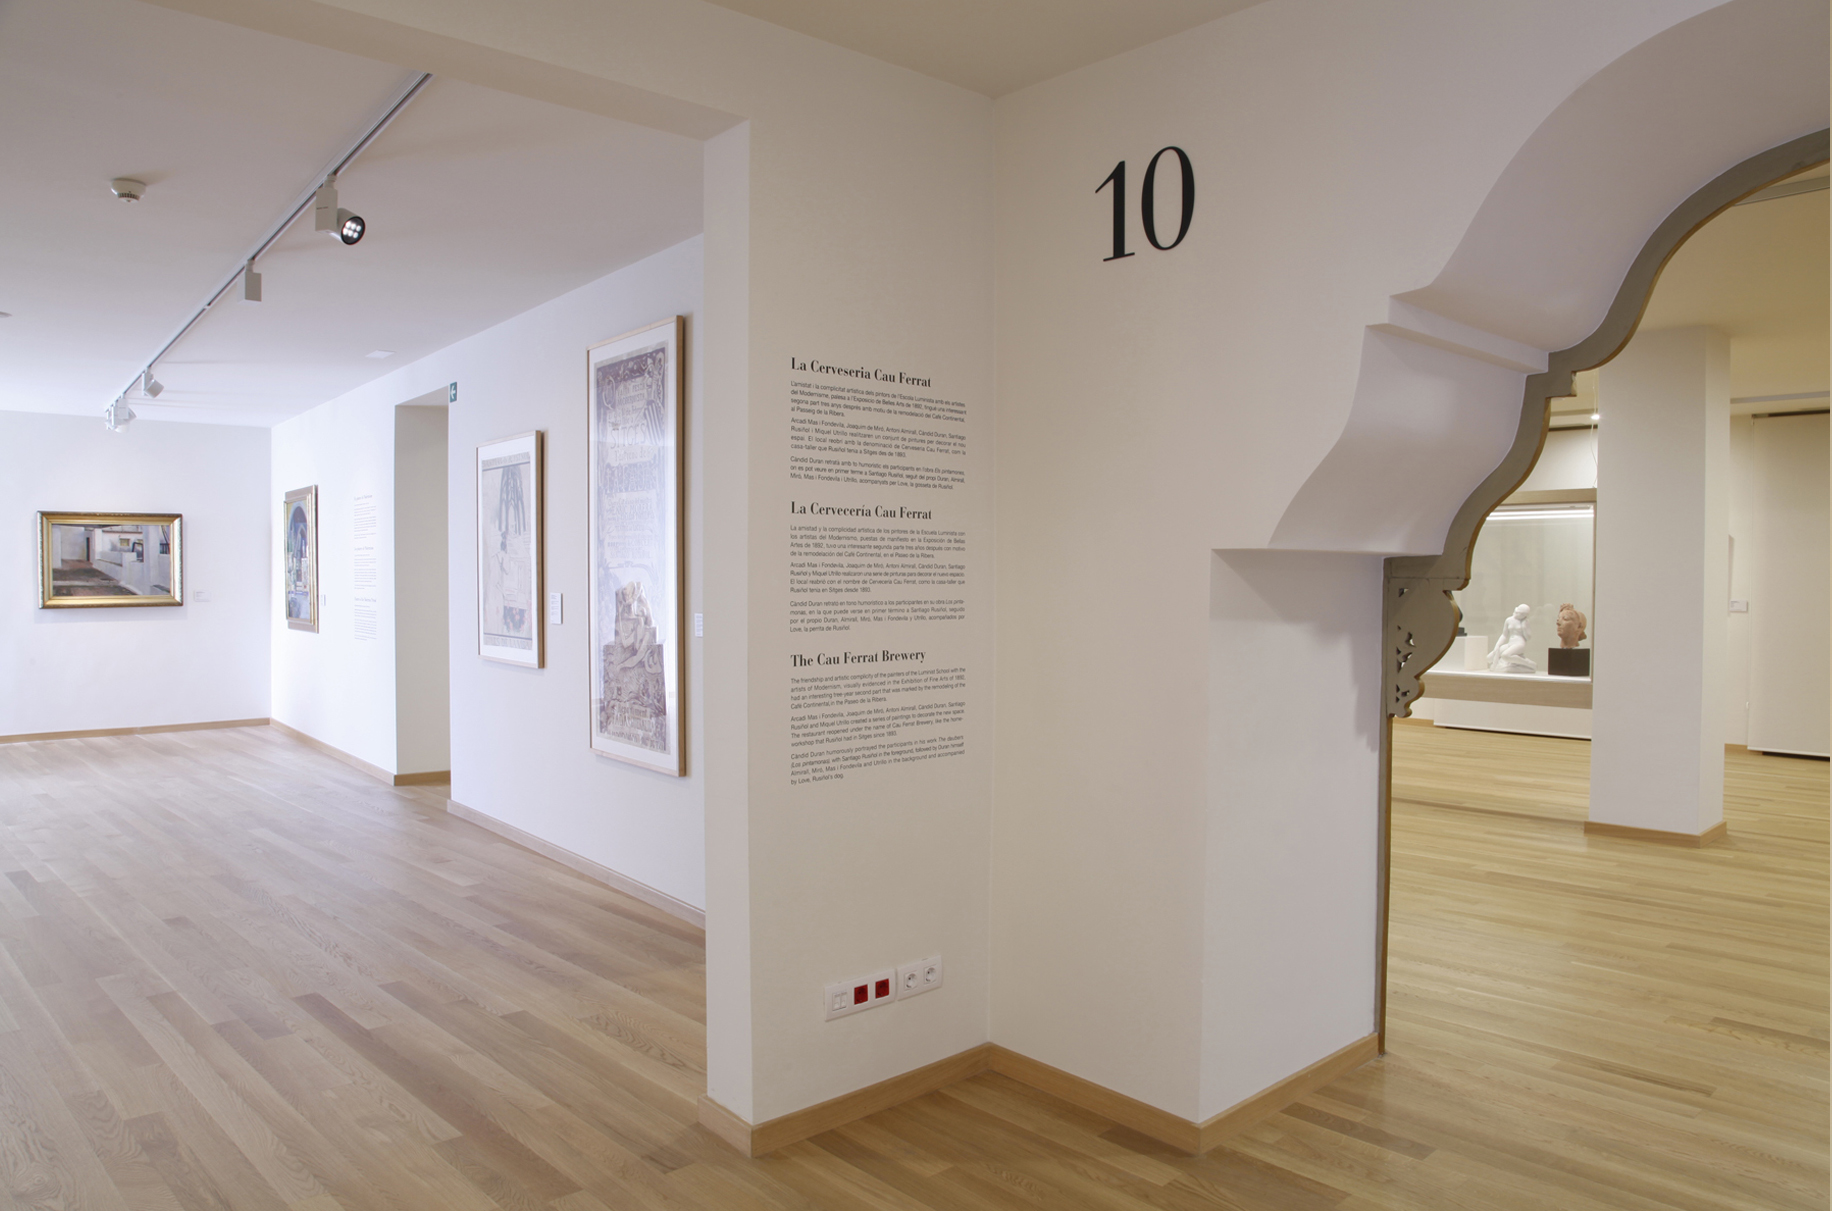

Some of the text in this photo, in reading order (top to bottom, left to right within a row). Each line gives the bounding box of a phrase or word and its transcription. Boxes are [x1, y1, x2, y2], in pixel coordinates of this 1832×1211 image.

[1095, 145, 1195, 262] 10
[791, 357, 931, 388] La Cerveseria Cau Ferrat
[796, 406, 815, 415] Passeig
[815, 427, 831, 435] Miquel
[846, 422, 866, 431] Joaquim
[863, 448, 878, 456] Sitges
[868, 469, 887, 478] Santiago
[791, 501, 932, 520] La Cervecería Cau Ferrat
[790, 650, 926, 667] The Cau Ferrat Brewery
[850, 673, 873, 681] complicity
[846, 709, 865, 718] Joaquim
[820, 720, 835, 728] Miquel
[801, 729, 826, 738] restaurant
[827, 727, 848, 736] reopened
[826, 746, 853, 755] humorously
[855, 743, 877, 753] portrayed
[840, 761, 862, 770] Fondevila
